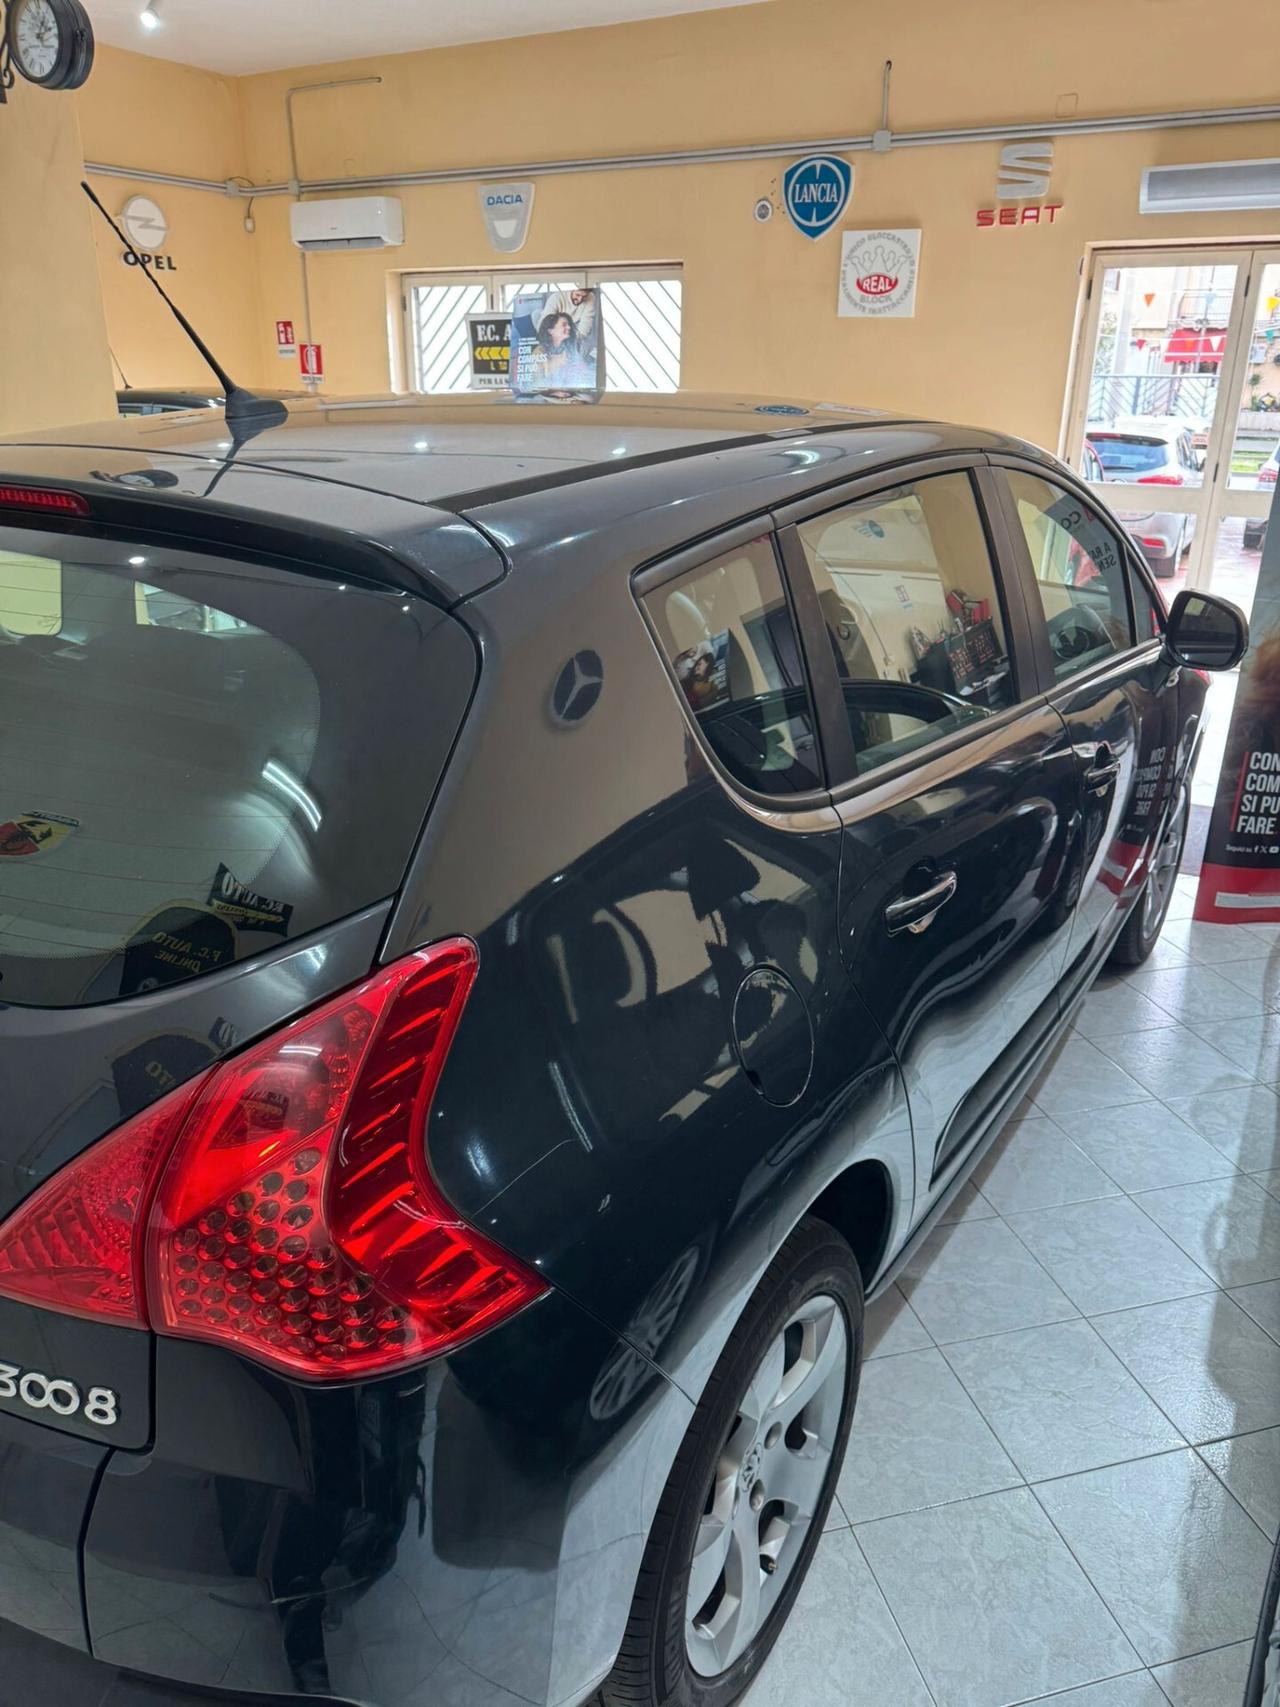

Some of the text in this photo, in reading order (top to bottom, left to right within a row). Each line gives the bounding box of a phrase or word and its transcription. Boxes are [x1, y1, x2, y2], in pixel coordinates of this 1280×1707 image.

[487, 194, 523, 206] DACIA
[795, 183, 838, 203] LANCIA
[976, 203, 1063, 226] SEAT
[123, 250, 177, 271] OPEL
[862, 275, 893, 293] REAL
[476, 324, 500, 341] F.C.
[1241, 794, 1257, 813] SI
[0, 1362, 117, 1425] 3008
